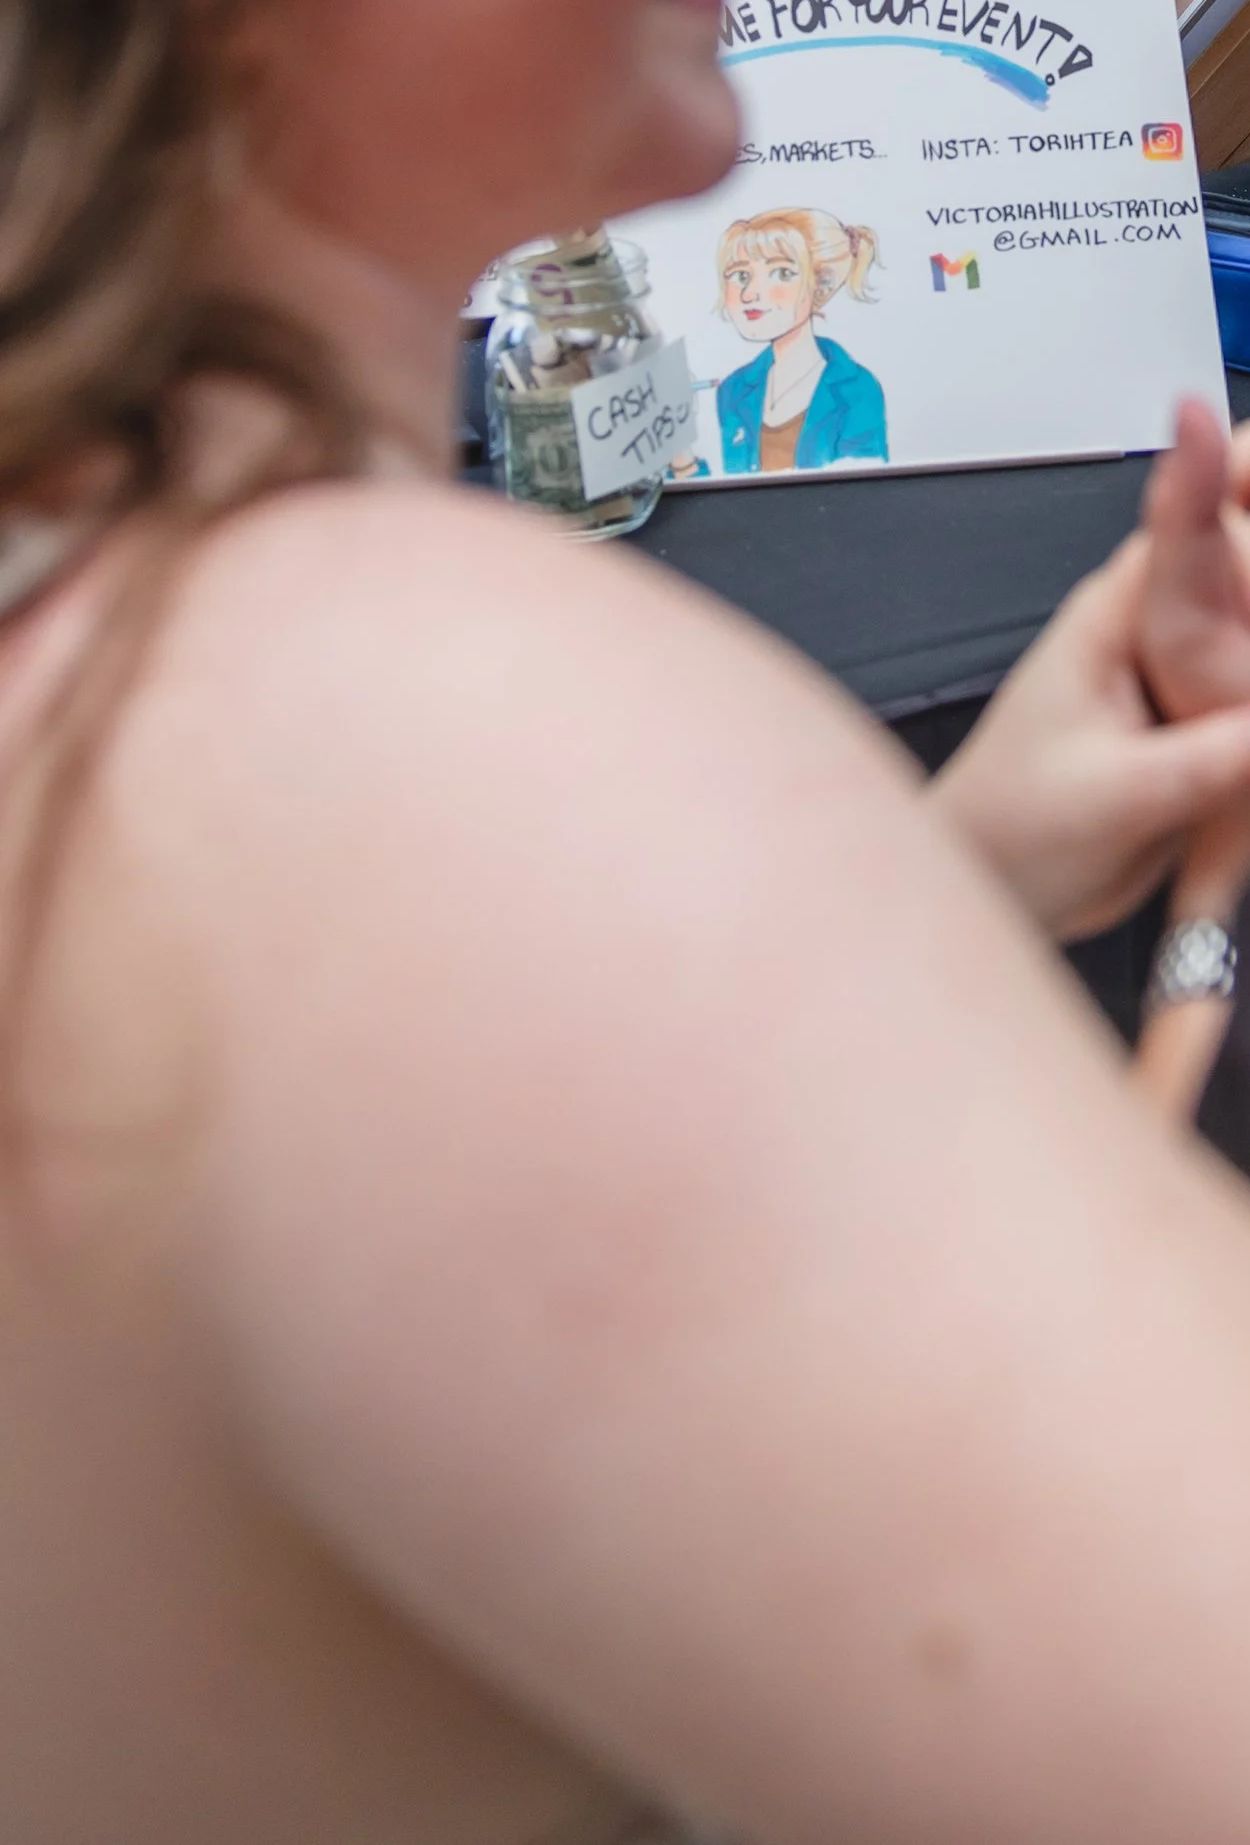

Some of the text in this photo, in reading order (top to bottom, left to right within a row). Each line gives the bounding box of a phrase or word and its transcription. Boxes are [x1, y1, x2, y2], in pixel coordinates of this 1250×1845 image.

[922, 131, 1133, 161] INSTA: TORIHTEA
[926, 196, 1199, 226] VICTORIAHILLUSTRATION
[994, 223, 1182, 252] @GMAIL.COM
[588, 370, 657, 441] CASH
[621, 404, 675, 464] TIPS
